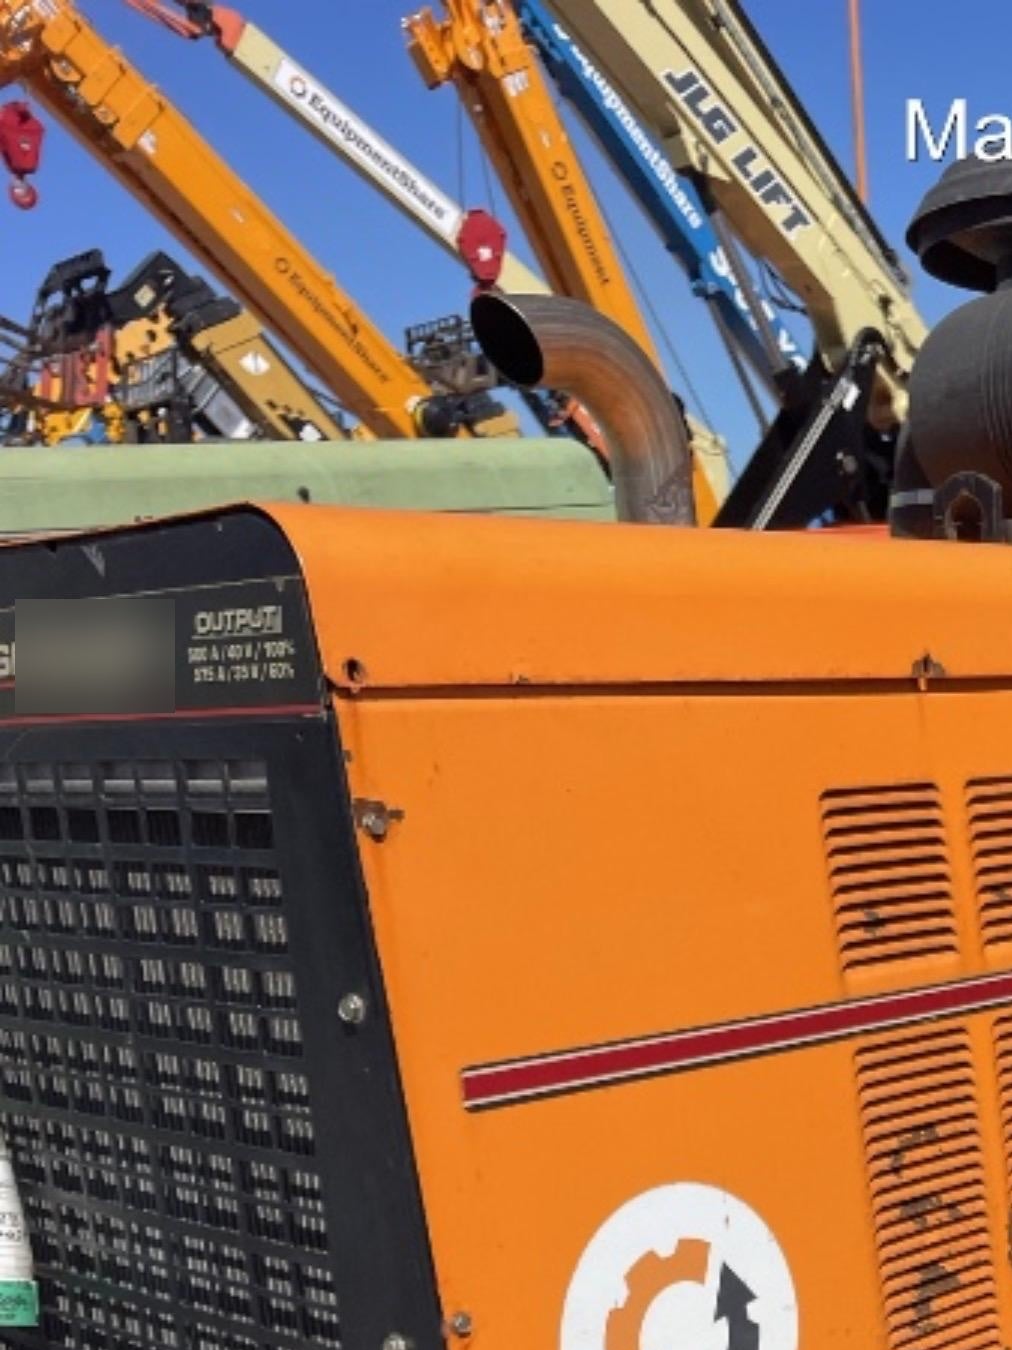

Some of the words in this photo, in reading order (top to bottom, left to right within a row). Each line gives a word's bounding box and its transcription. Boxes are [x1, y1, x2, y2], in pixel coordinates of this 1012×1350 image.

[308, 94, 446, 220] EquipmentShare
[664, 71, 737, 145] JLG
[732, 147, 811, 232] LIFT
[193, 605, 278, 635] OUTPUT
